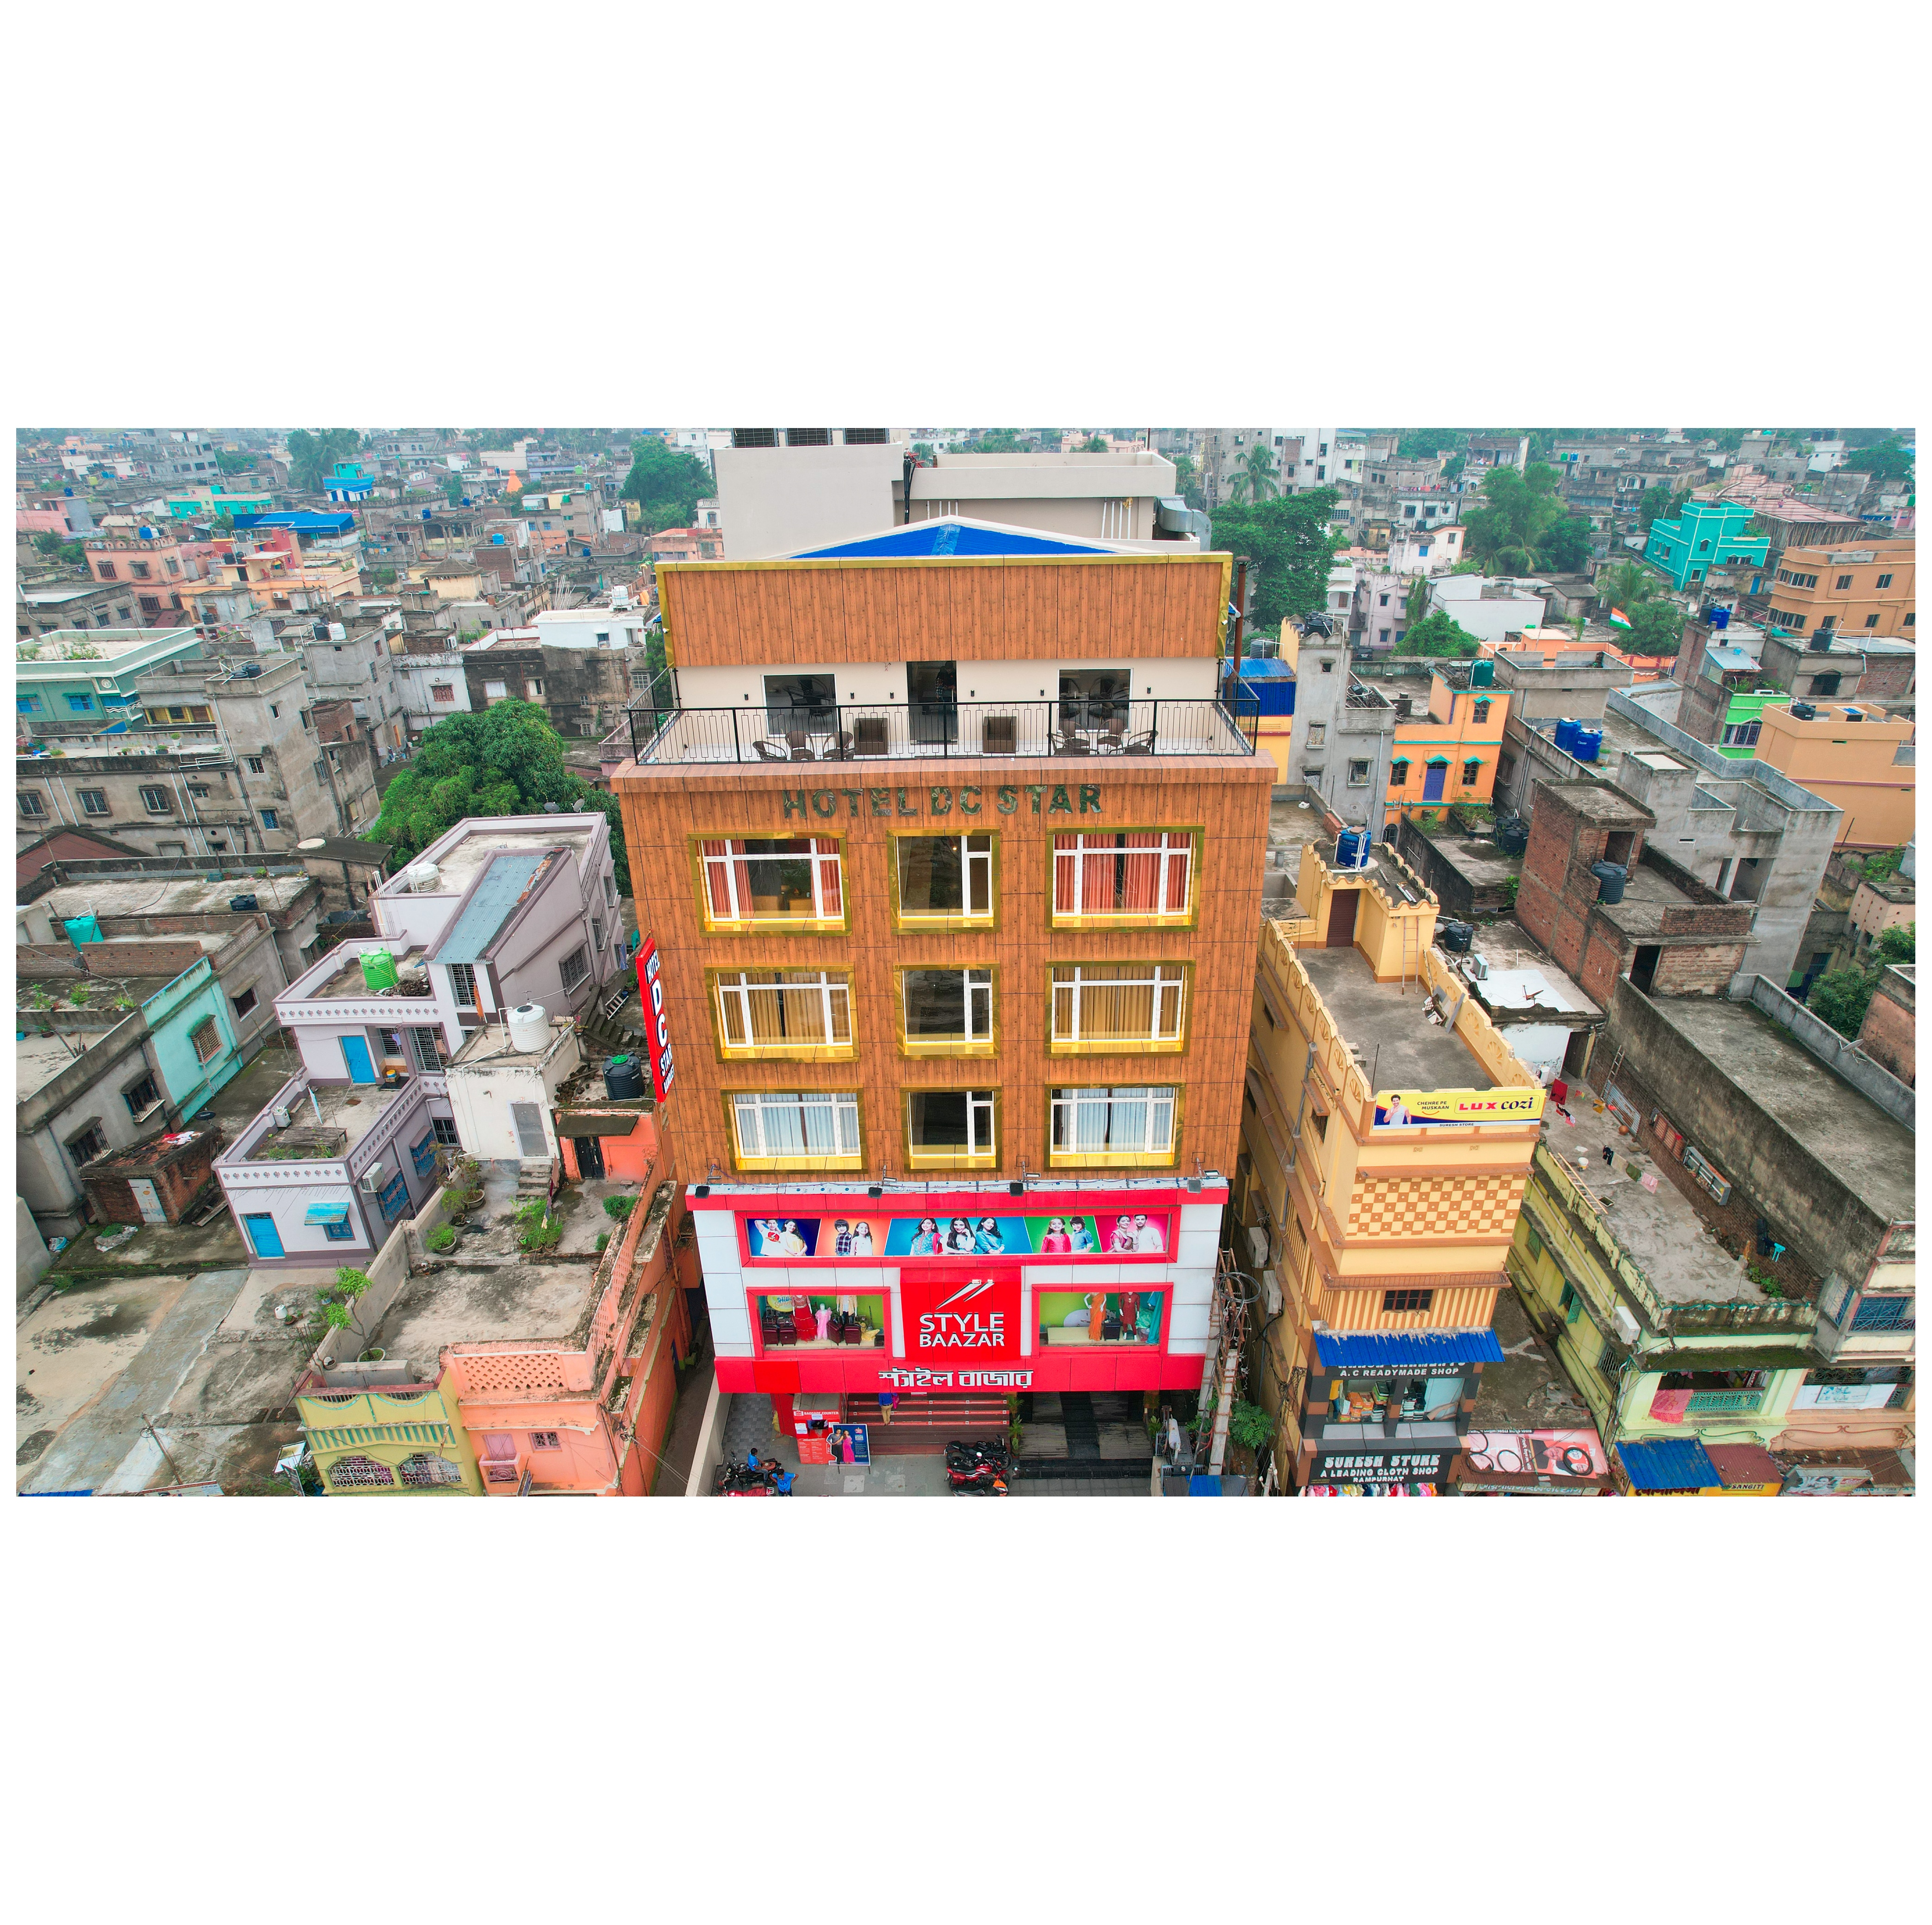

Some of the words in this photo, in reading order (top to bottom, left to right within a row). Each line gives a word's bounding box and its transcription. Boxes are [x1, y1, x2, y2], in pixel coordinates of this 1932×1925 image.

[782, 787, 917, 819] HOTEL
[931, 785, 982, 816] DC
[997, 784, 1102, 815] STAR
[645, 949, 660, 984] HOTEL
[659, 1043, 672, 1077] STAR
[1459, 1102, 1498, 1111] LUX
[1501, 1097, 1534, 1110] cozi
[919, 1312, 1004, 1332] STYLE
[919, 1332, 1005, 1347] BAAZAR
[878, 1366, 954, 1387] স্টাইল
[958, 1370, 1033, 1389] বাজার
[1324, 1456, 1384, 1468] SURESH
[1391, 1454, 1441, 1466] STORE
[1330, 1469, 1373, 1477] LEADING
